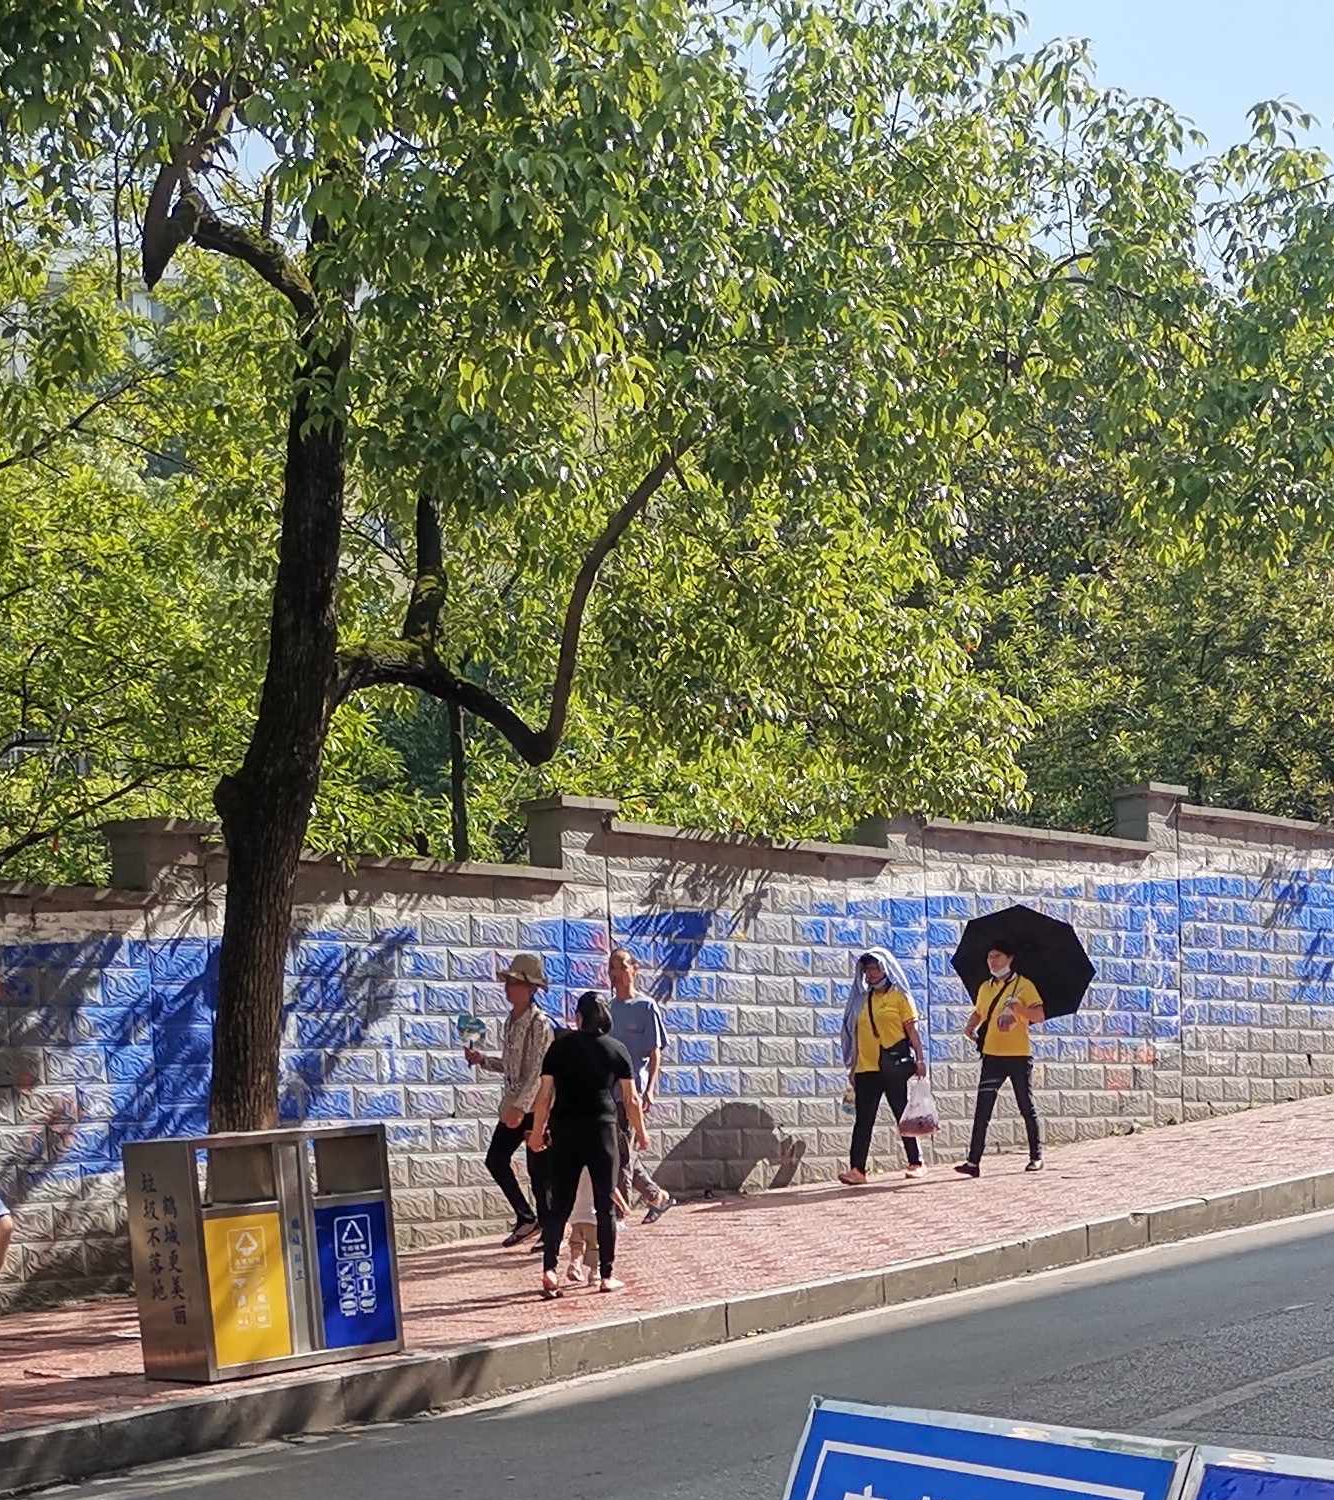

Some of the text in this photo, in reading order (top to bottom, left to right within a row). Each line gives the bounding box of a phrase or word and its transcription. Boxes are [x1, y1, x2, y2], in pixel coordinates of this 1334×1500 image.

[141, 1172, 168, 1301] 垃圾不落地
